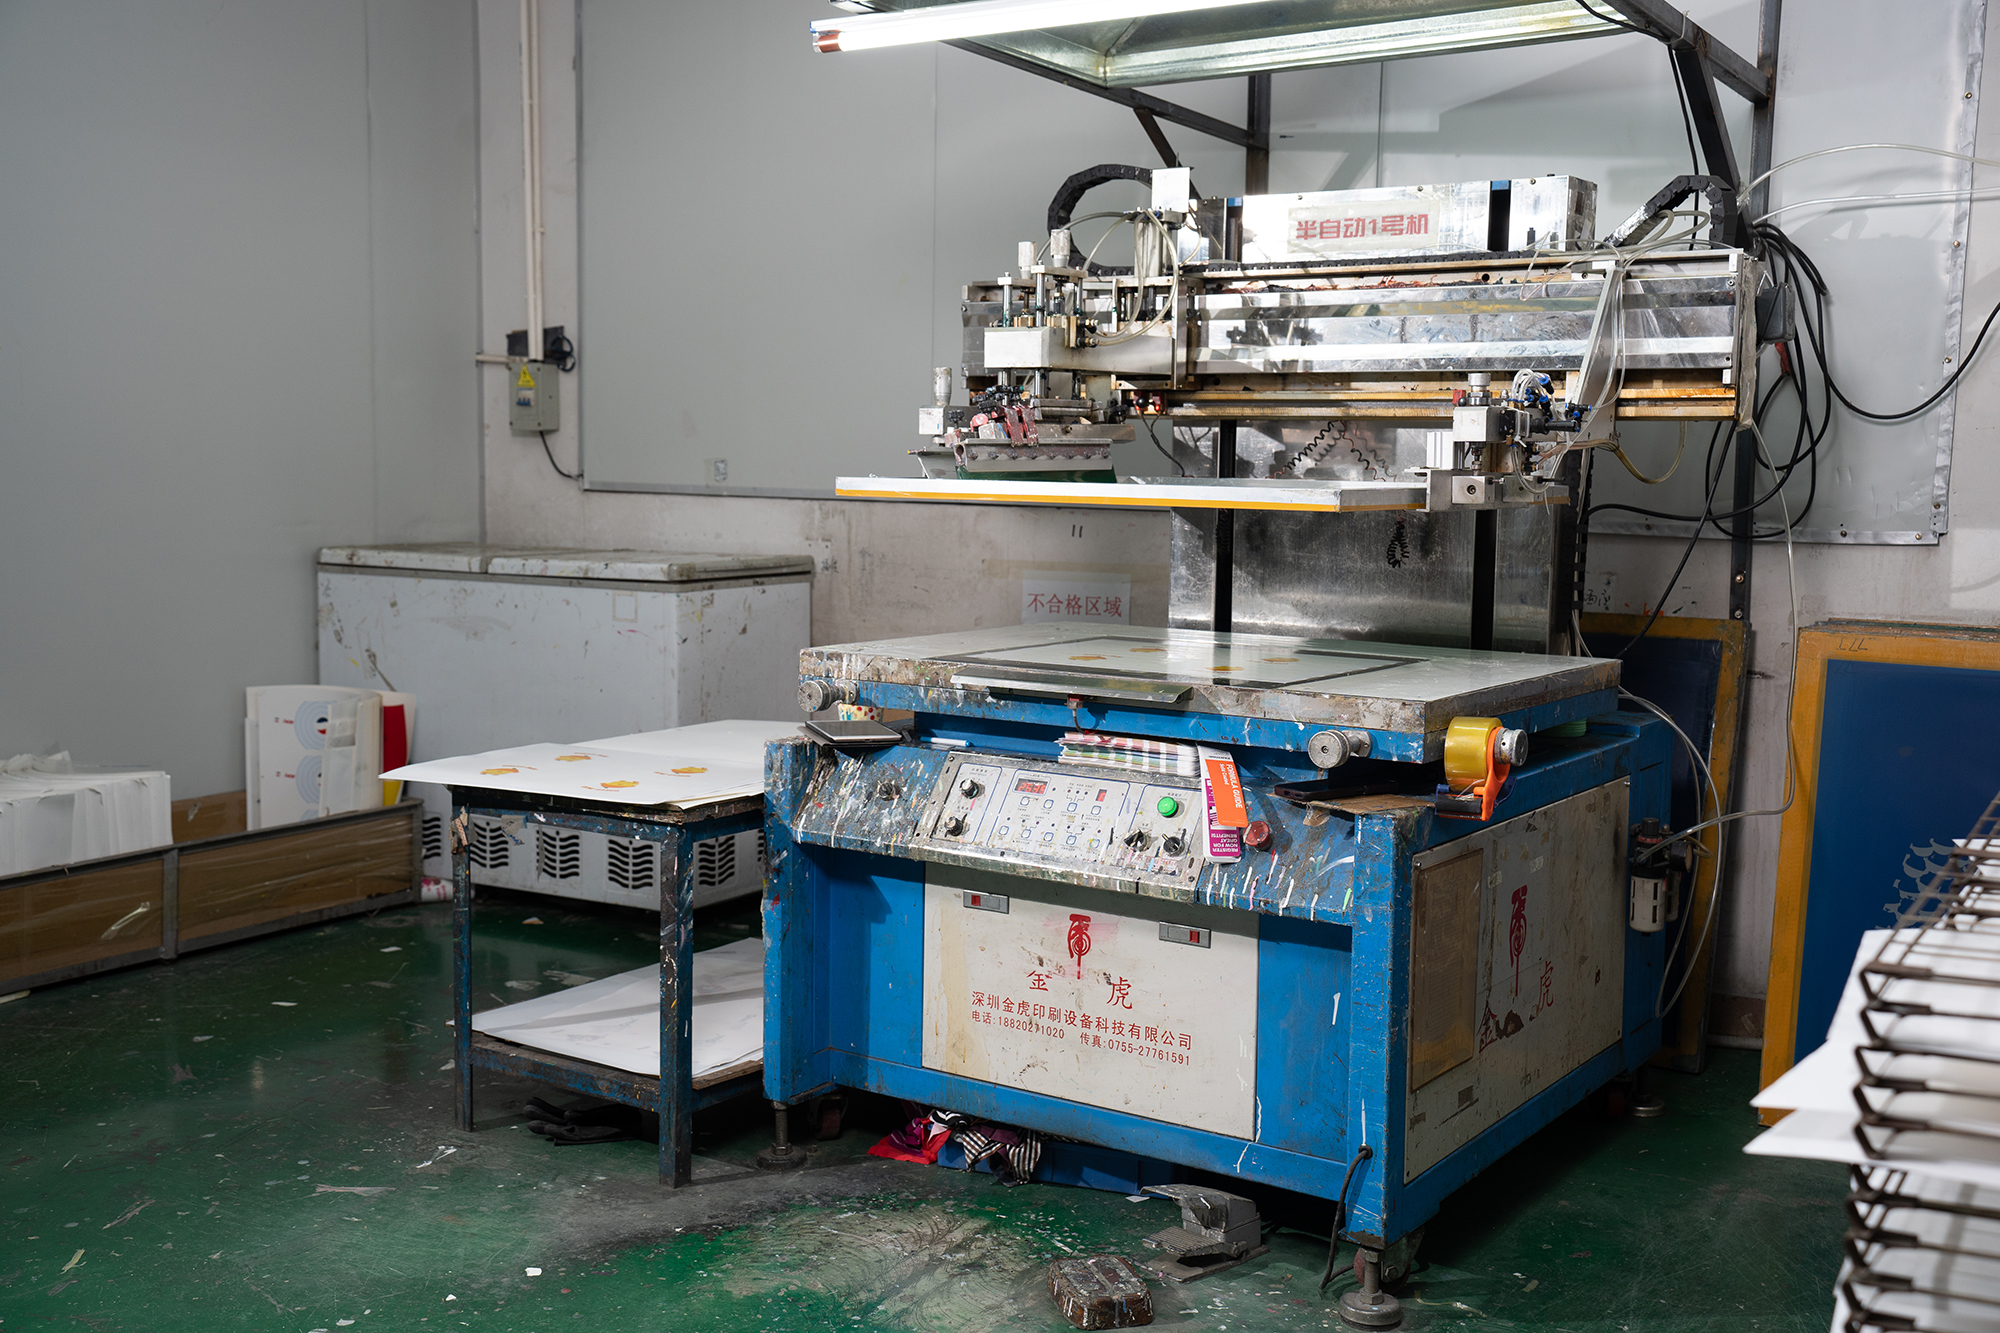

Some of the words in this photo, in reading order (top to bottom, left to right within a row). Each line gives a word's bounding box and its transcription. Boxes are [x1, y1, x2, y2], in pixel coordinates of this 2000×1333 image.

[1295, 213, 1429, 240] 半自动1号机
[1027, 592, 1122, 618] 不合格区域
[1226, 764, 1238, 789] FORMULA
[1232, 789, 1243, 808] GUIDE
[1026, 969, 1052, 992] 金
[1106, 976, 1134, 1010] 虎
[971, 990, 1192, 1051] 深圳金虎印刷设备科技有限公司
